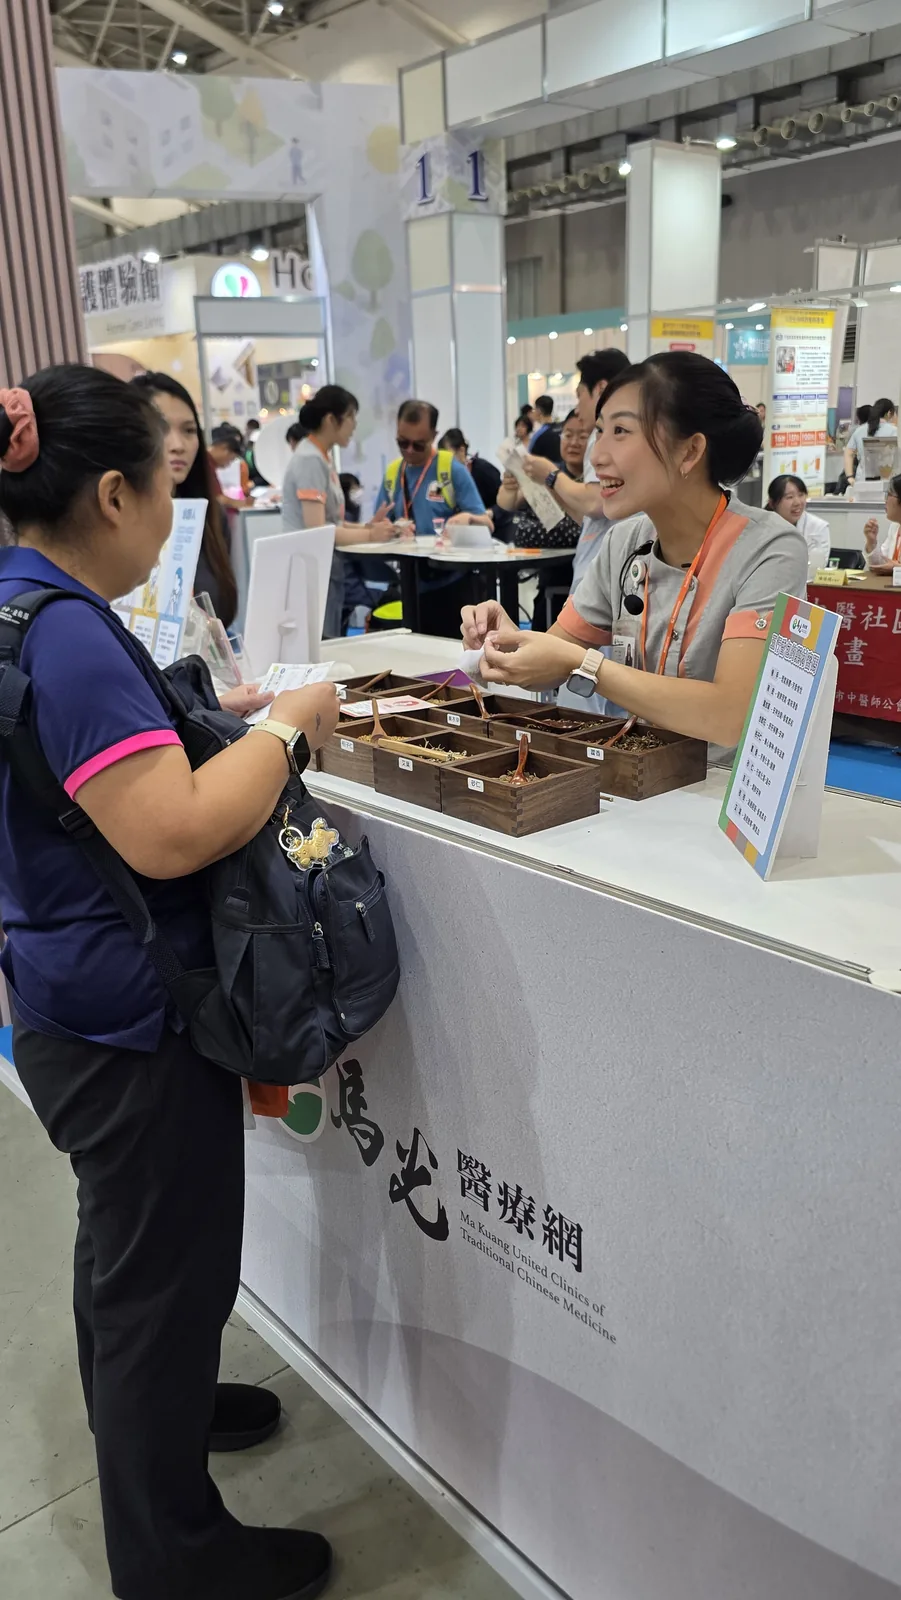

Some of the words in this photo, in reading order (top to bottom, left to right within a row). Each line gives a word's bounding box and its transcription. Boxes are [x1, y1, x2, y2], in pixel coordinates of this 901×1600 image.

[457, 1149, 583, 1272] 醫療網
[460, 1211, 476, 1230] Ma
[478, 1221, 509, 1254] Kuang
[512, 1244, 548, 1279] United
[550, 1271, 590, 1305] Clinics
[592, 1302, 606, 1318] of
[460, 1227, 515, 1273] Traditional
[517, 1266, 560, 1304] Chinese
[563, 1298, 617, 1344] Medicine
